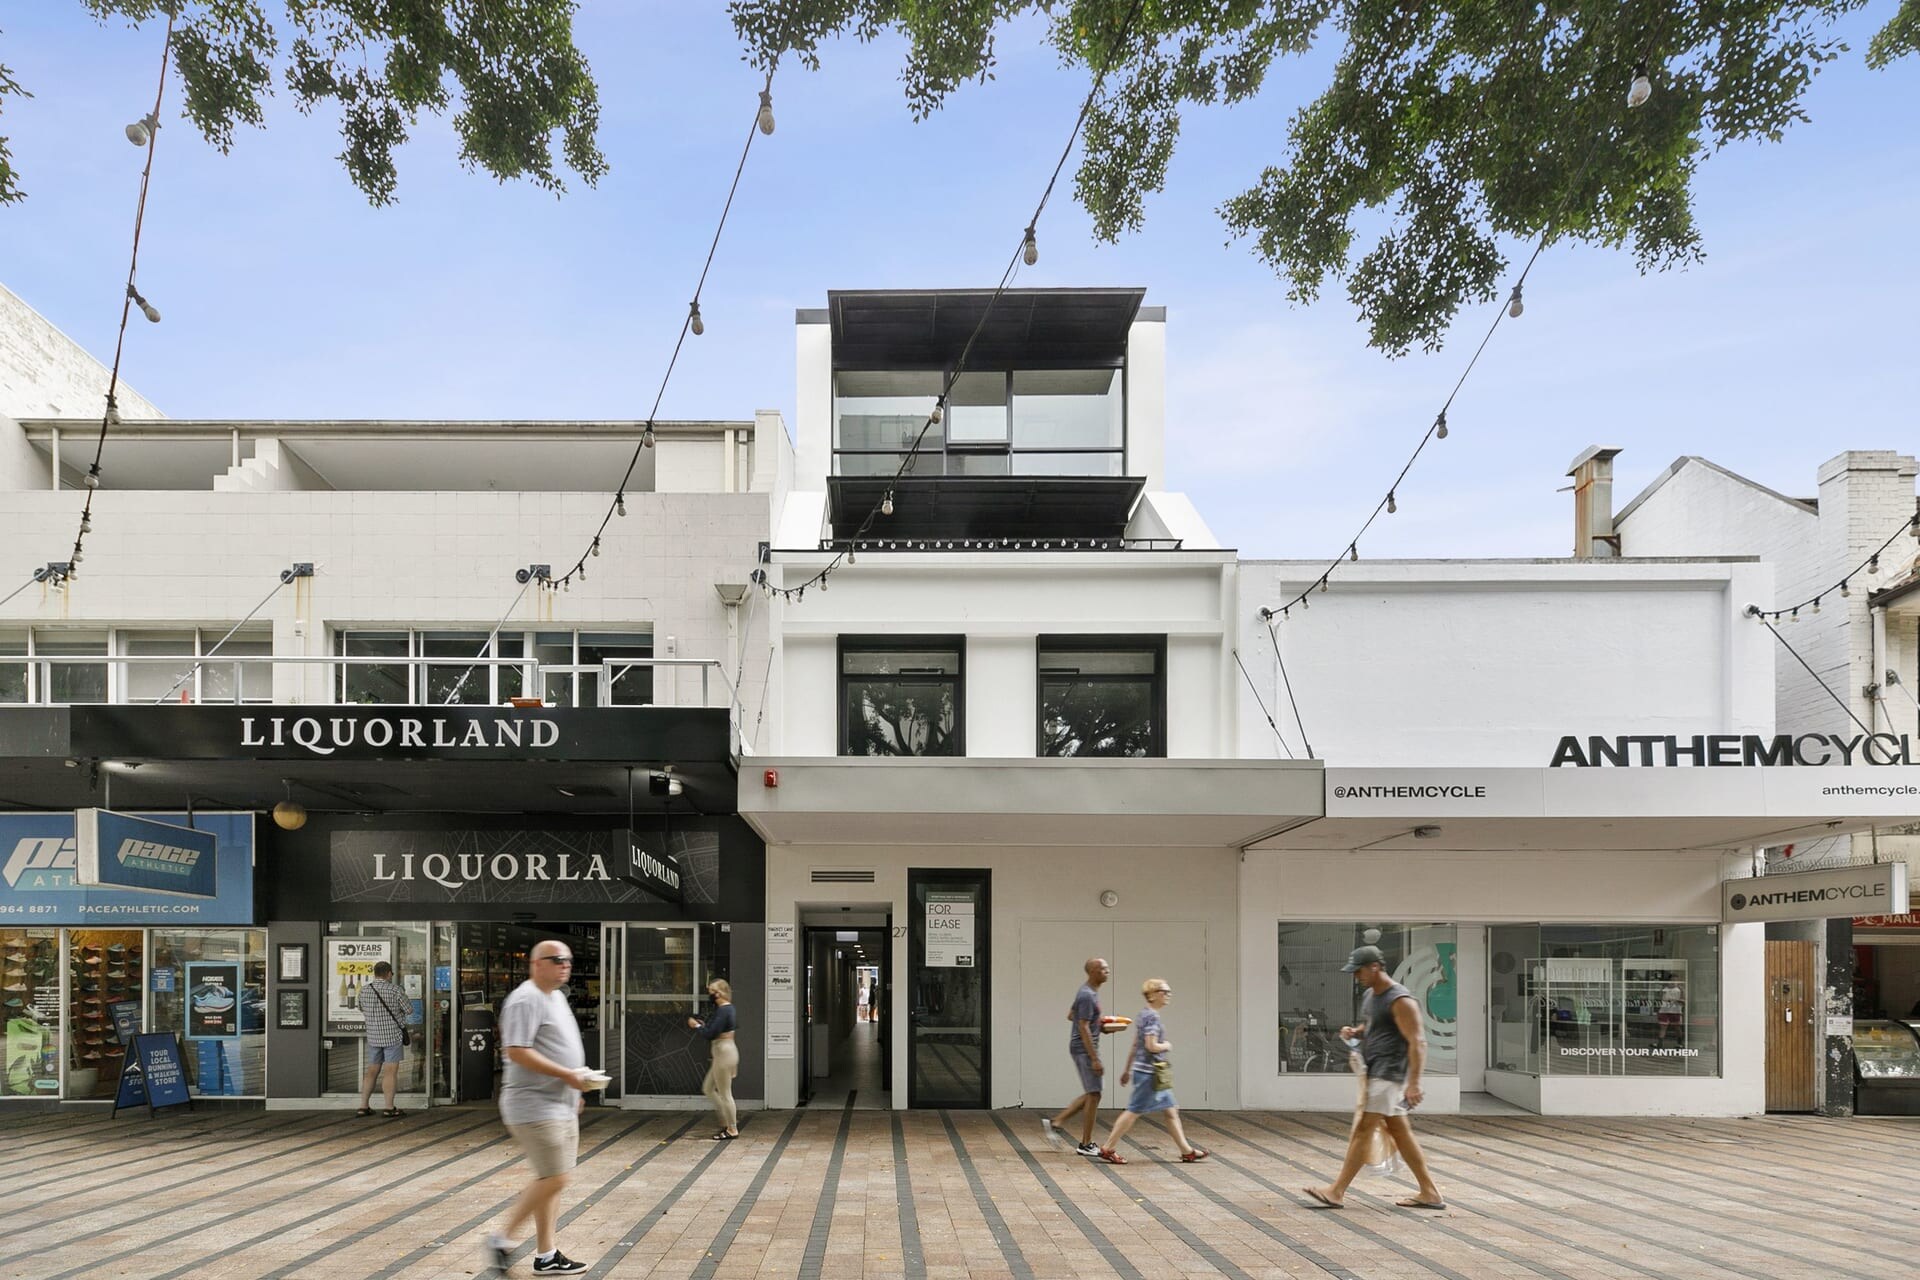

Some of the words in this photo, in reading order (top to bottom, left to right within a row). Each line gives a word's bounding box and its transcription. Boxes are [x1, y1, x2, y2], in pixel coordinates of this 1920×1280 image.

[241, 718, 560, 755] LIQUORLAND
[1334, 786, 1486, 798] @ANTHEMCYCLE
[117, 838, 201, 865] pace
[130, 858, 186, 874] ATHLETIC
[631, 844, 680, 890] LIQUORLAND
[1749, 883, 1886, 907] ANTHEMCYCLE
[29, 905, 58, 914] 8871
[78, 905, 200, 914] PACEATHLETIC.COM
[928, 904, 952, 915] FOR
[928, 919, 961, 929] LEASE
[892, 927, 907, 938] 27
[338, 944, 356, 957] 50
[356, 944, 382, 952] YEARS
[349, 964, 356, 973] 2
[150, 1049, 168, 1057] YOUR
[1560, 1048, 1616, 1056] DISCOVER
[1618, 1048, 1650, 1056] YOUR
[1652, 1048, 1699, 1057] ANTHEM
[151, 1056, 171, 1064] LOCAL
[148, 1062, 177, 1072] RUNNING
[153, 1069, 180, 1079] WALKING
[155, 1076, 177, 1086] STORE
